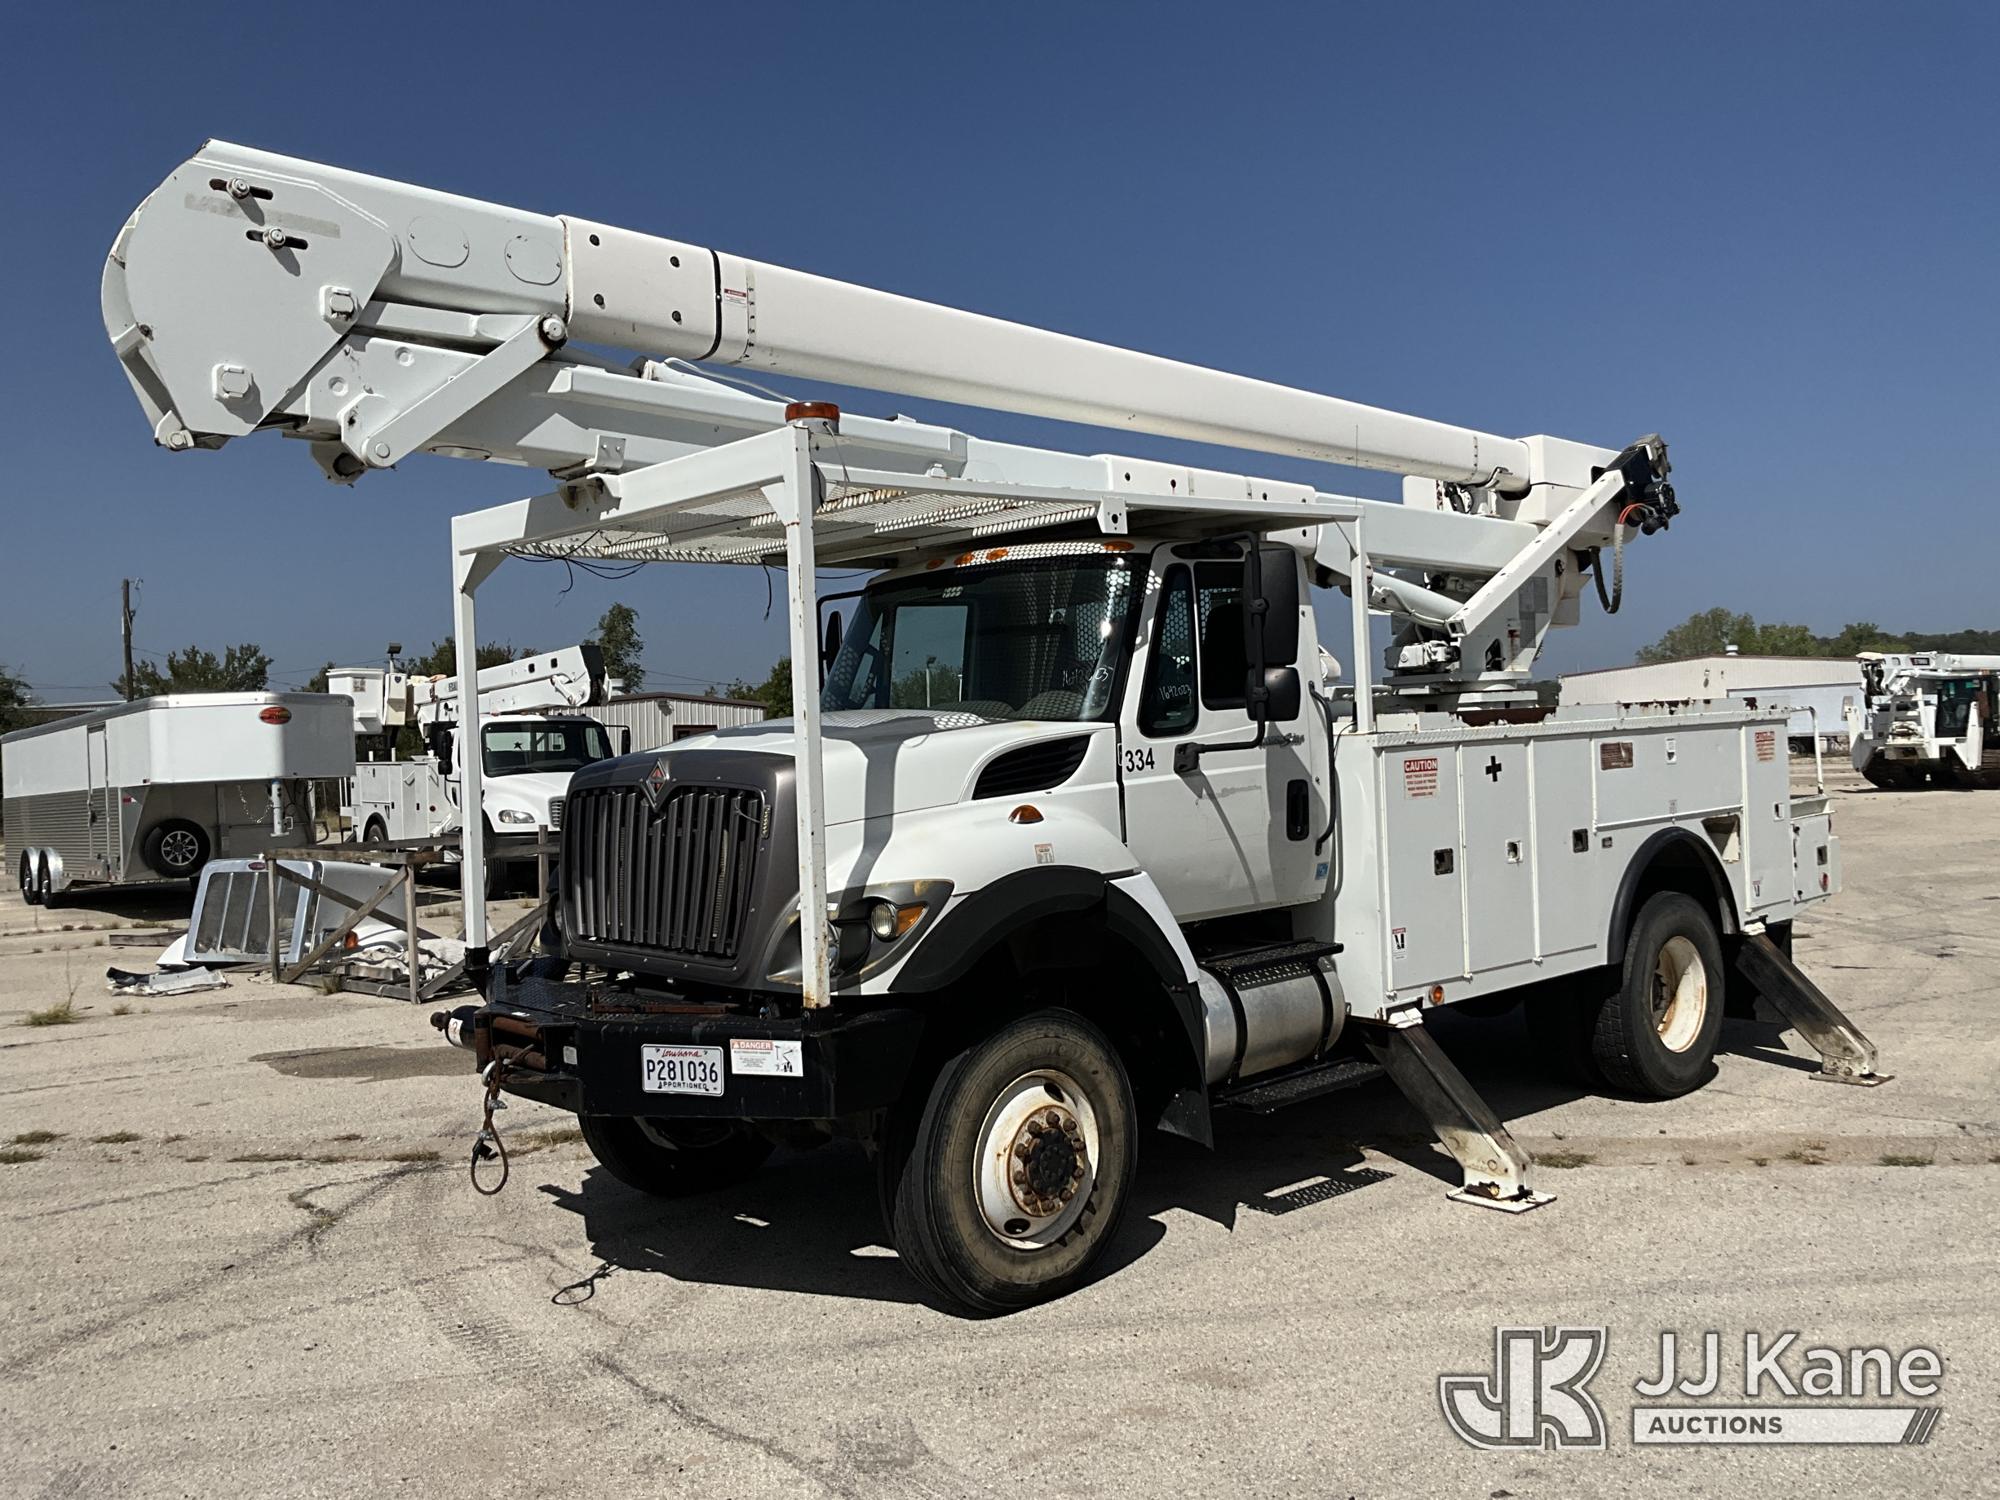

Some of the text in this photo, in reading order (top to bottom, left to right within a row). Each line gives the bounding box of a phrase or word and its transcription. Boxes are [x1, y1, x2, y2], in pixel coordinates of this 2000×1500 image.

[1125, 747, 1155, 772] 334
[1405, 760, 1437, 772] CAUTION
[740, 1041, 771, 1050] DANGER
[662, 1049, 702, 1058] Louisiana
[646, 1059, 718, 1083] P281036
